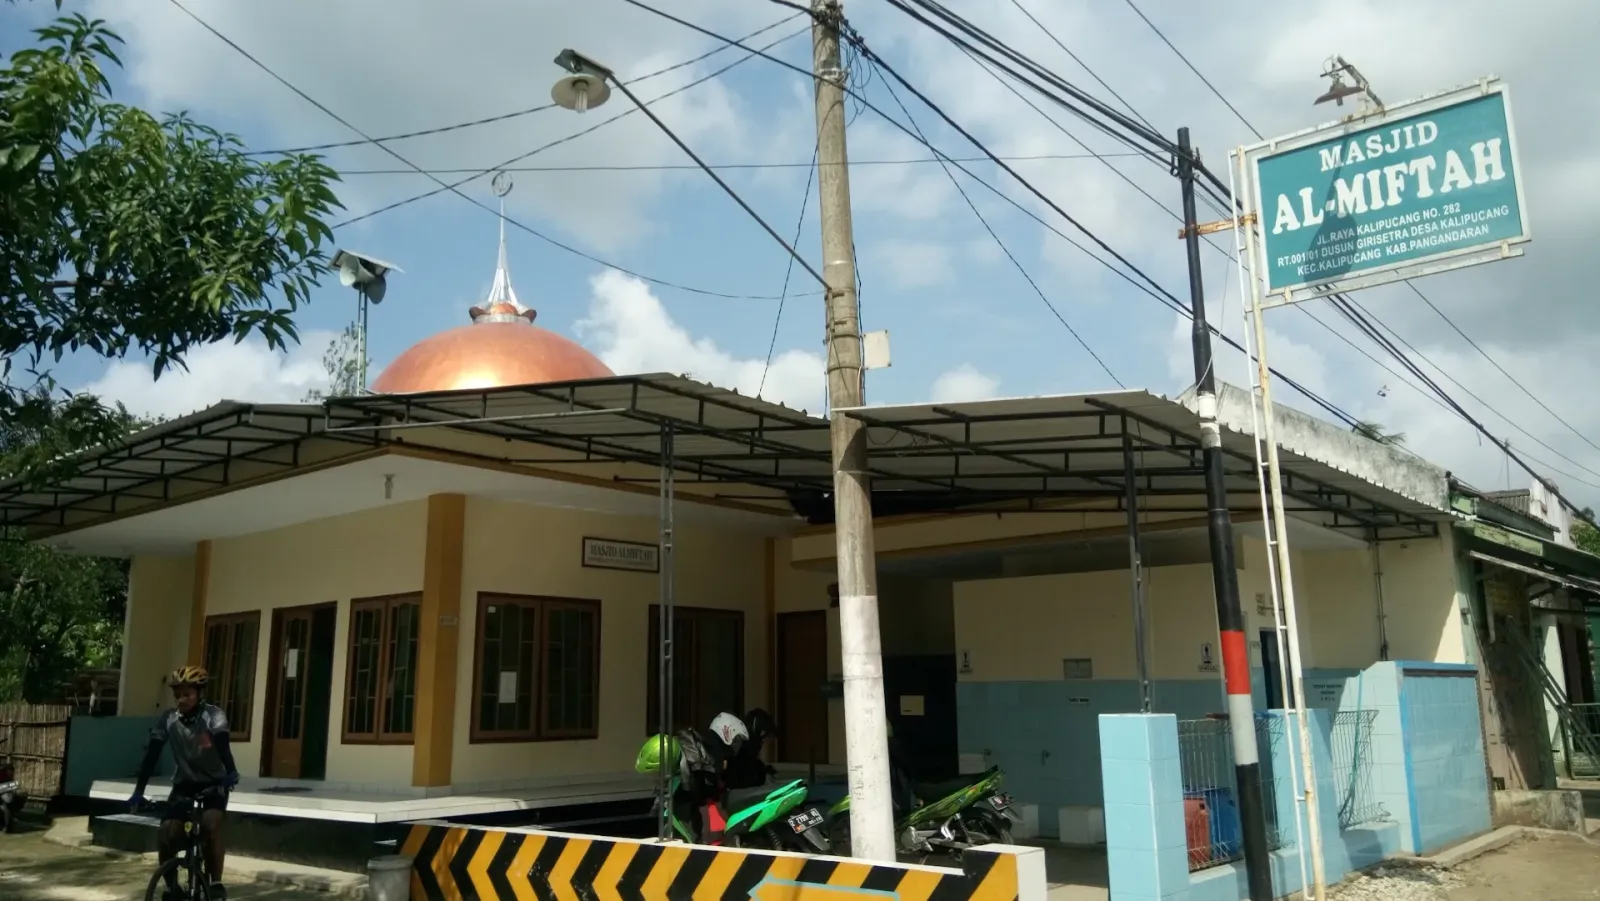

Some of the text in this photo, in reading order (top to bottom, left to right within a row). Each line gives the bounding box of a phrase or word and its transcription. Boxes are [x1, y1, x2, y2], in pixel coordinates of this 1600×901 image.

[1319, 120, 1438, 172] MASJID
[1272, 138, 1506, 234] AL-MIFTAH
[1278, 205, 1509, 267] RT.001/01 DUSUN GIRISETRA DESA KALIPUCANG
[1317, 202, 1461, 245] JL.RAYA KALIPUCANG NO. 282
